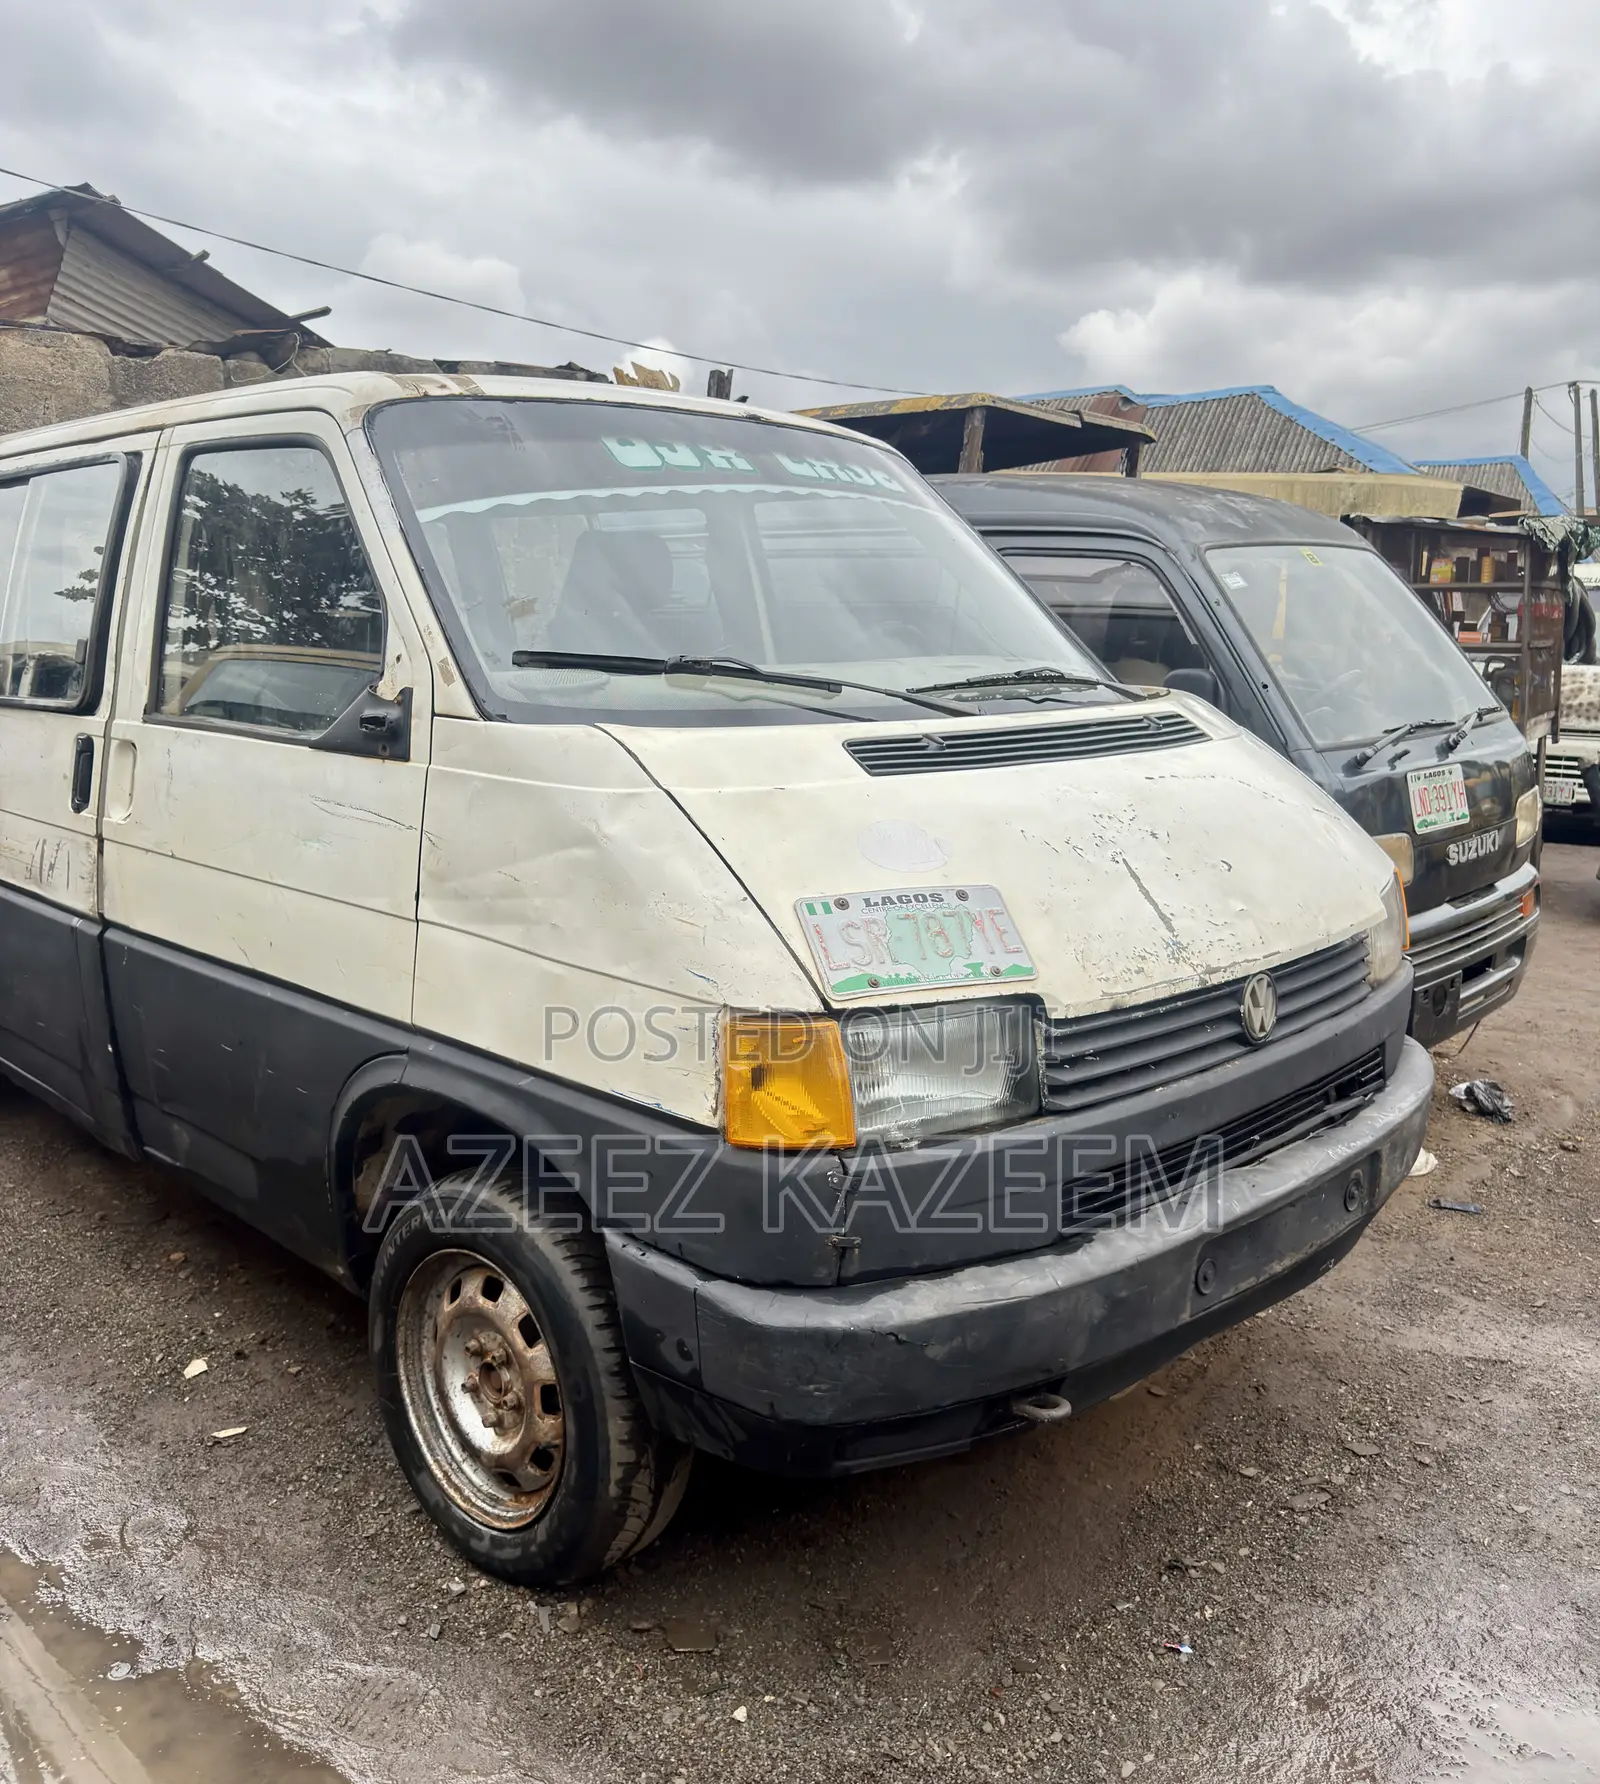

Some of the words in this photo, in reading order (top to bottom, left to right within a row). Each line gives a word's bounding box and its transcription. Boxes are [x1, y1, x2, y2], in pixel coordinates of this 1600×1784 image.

[1423, 769, 1446, 780] LAGOS
[1446, 830, 1499, 866] SUZUKI
[862, 892, 945, 908] LAGOS
[860, 905, 891, 915] CENTRE
[905, 902, 953, 911] EXCELLENCE
